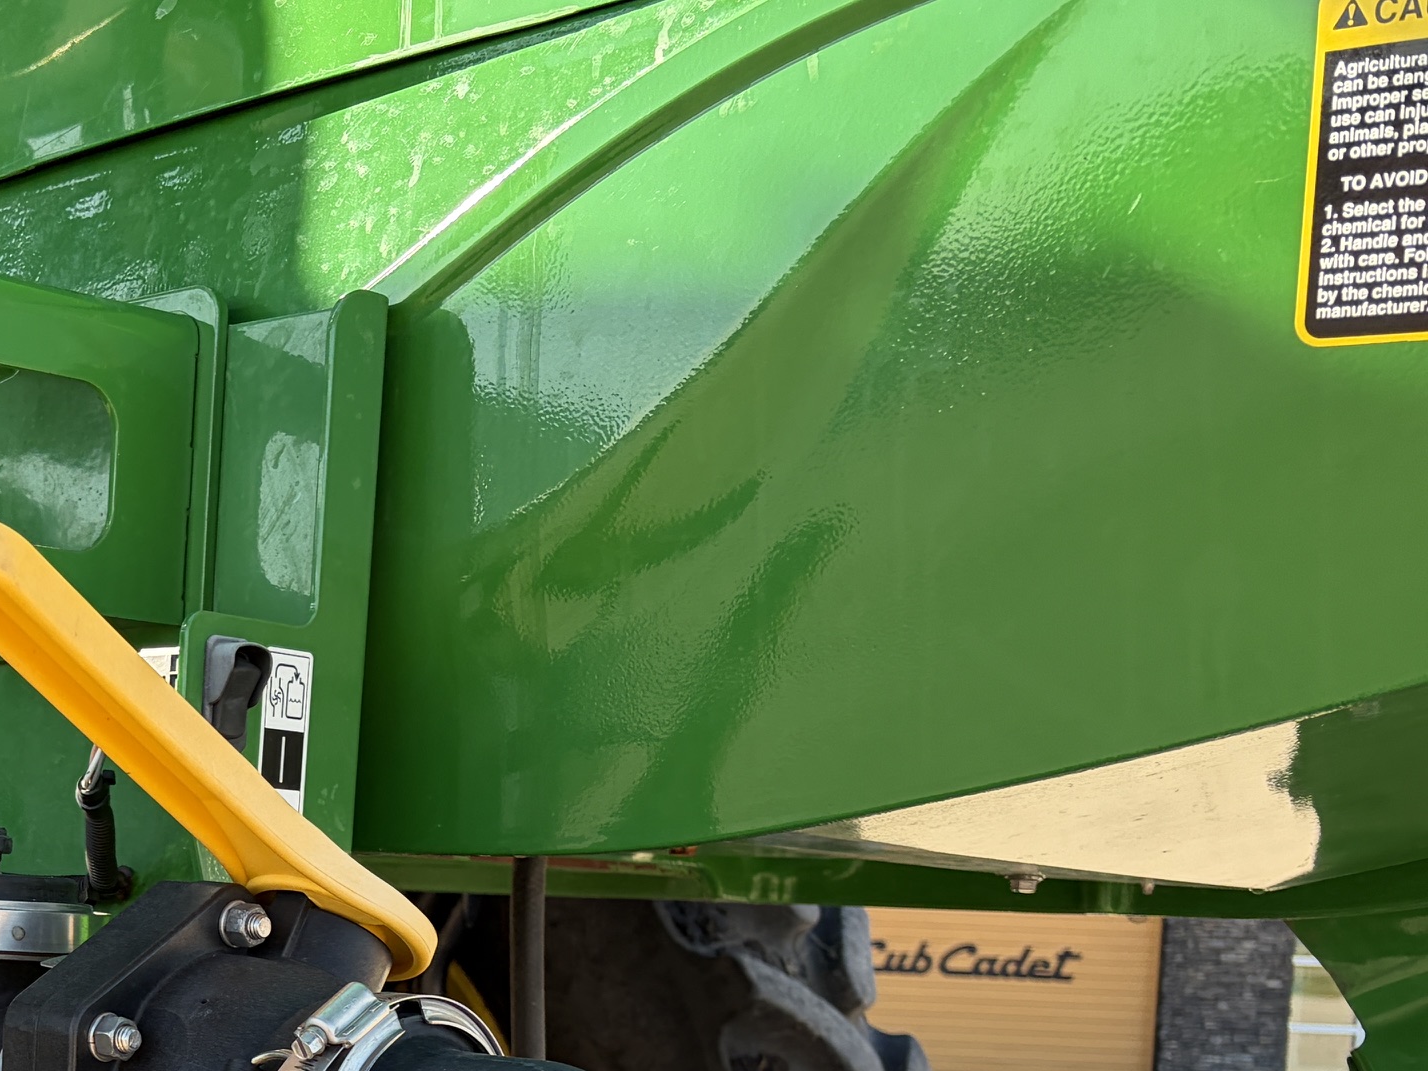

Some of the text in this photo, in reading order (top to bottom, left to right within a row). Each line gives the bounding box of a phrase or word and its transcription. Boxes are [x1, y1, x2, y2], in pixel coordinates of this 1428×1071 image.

[1375, 0, 1428, 24] CA
[1334, 53, 1428, 78] Agricultura
[1332, 78, 1364, 94] can
[1367, 74, 1390, 89] be
[1331, 89, 1408, 111] Improper
[1330, 112, 1362, 128] use
[1364, 108, 1396, 123] can
[1328, 119, 1428, 145] animals, pla
[1327, 139, 1428, 161] or other pro
[1340, 169, 1428, 192] TO AVOID
[1324, 197, 1426, 220] 1. Select the
[1322, 214, 1426, 236] chemical for
[1320, 238, 1335, 253] 2.
[1339, 233, 1399, 252] Handle
[1319, 253, 1355, 270] with
[1358, 251, 1400, 267] care.
[1318, 266, 1418, 286] instructions
[1316, 288, 1338, 305] by
[1341, 286, 1369, 301] the
[939, 942, 1082, 982] Cadet
